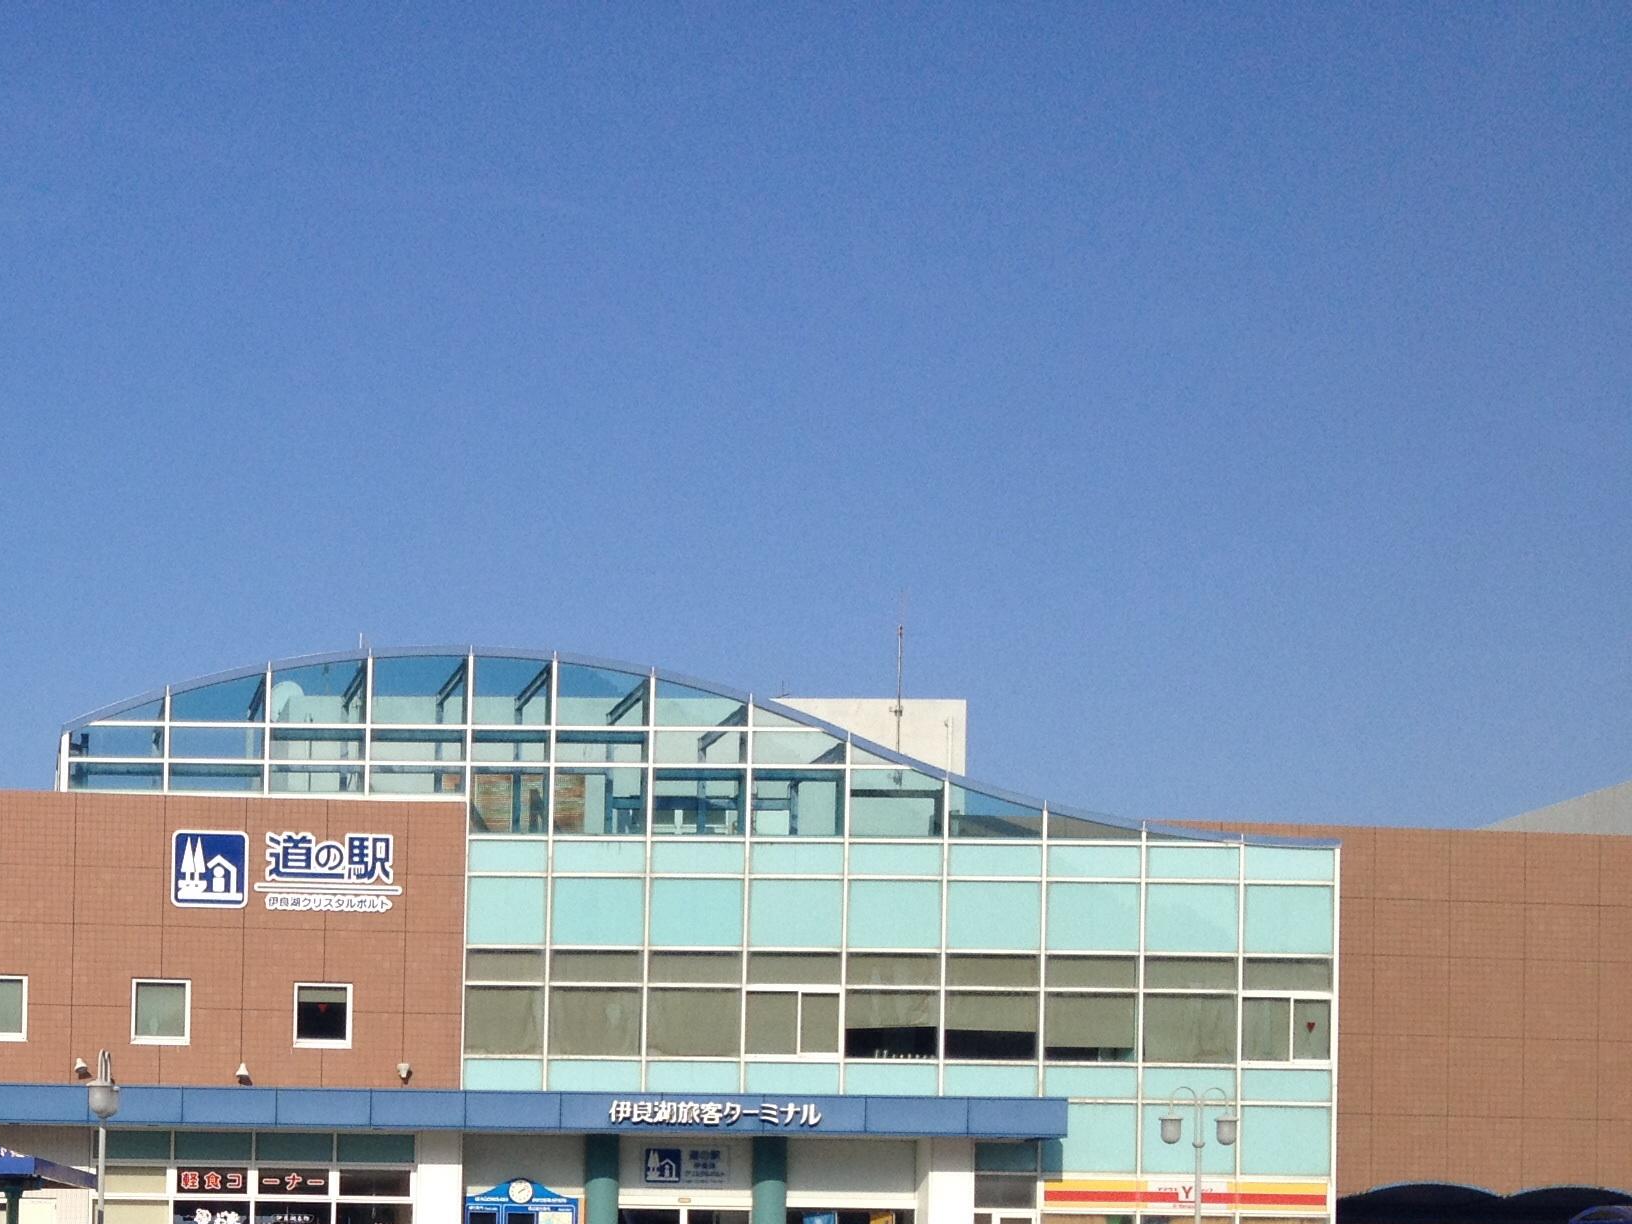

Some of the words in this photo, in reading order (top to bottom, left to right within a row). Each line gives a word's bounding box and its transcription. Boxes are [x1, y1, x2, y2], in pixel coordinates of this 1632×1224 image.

[268, 834, 391, 881] 道の駅
[268, 896, 389, 910] 伊良湖クリスタルポルト
[609, 1099, 822, 1127] 伊良湖旅客ターミナル
[181, 1171, 325, 1191] 軽食コーナー
